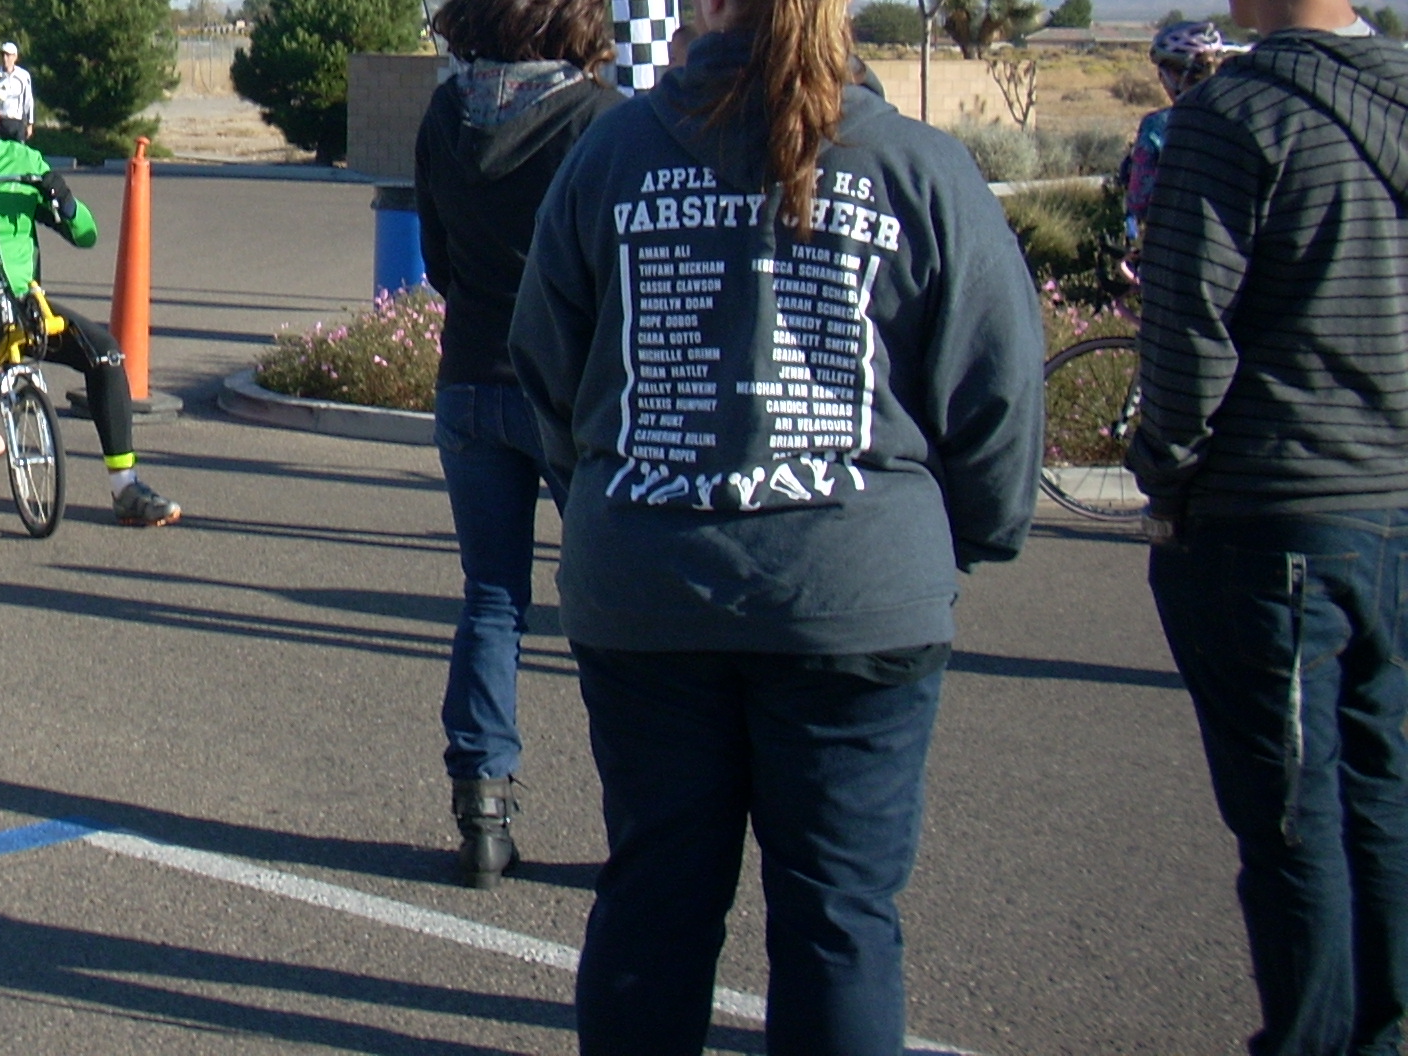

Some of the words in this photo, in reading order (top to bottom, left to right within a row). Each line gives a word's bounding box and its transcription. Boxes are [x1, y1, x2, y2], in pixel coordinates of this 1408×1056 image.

[641, 167, 717, 193] APPLE
[832, 171, 875, 202] H.S.
[613, 194, 766, 235] VARSITY
[674, 244, 691, 258] ALI
[792, 244, 830, 262] TAYLOR
[676, 278, 721, 293] CLAWSON
[777, 296, 812, 312] SARAH
[826, 320, 861, 338] SMITH
[773, 330, 821, 348] SCARLETT
[824, 336, 859, 355] SMITH
[637, 348, 682, 362] MICHELLE
[787, 383, 808, 398] VAN
